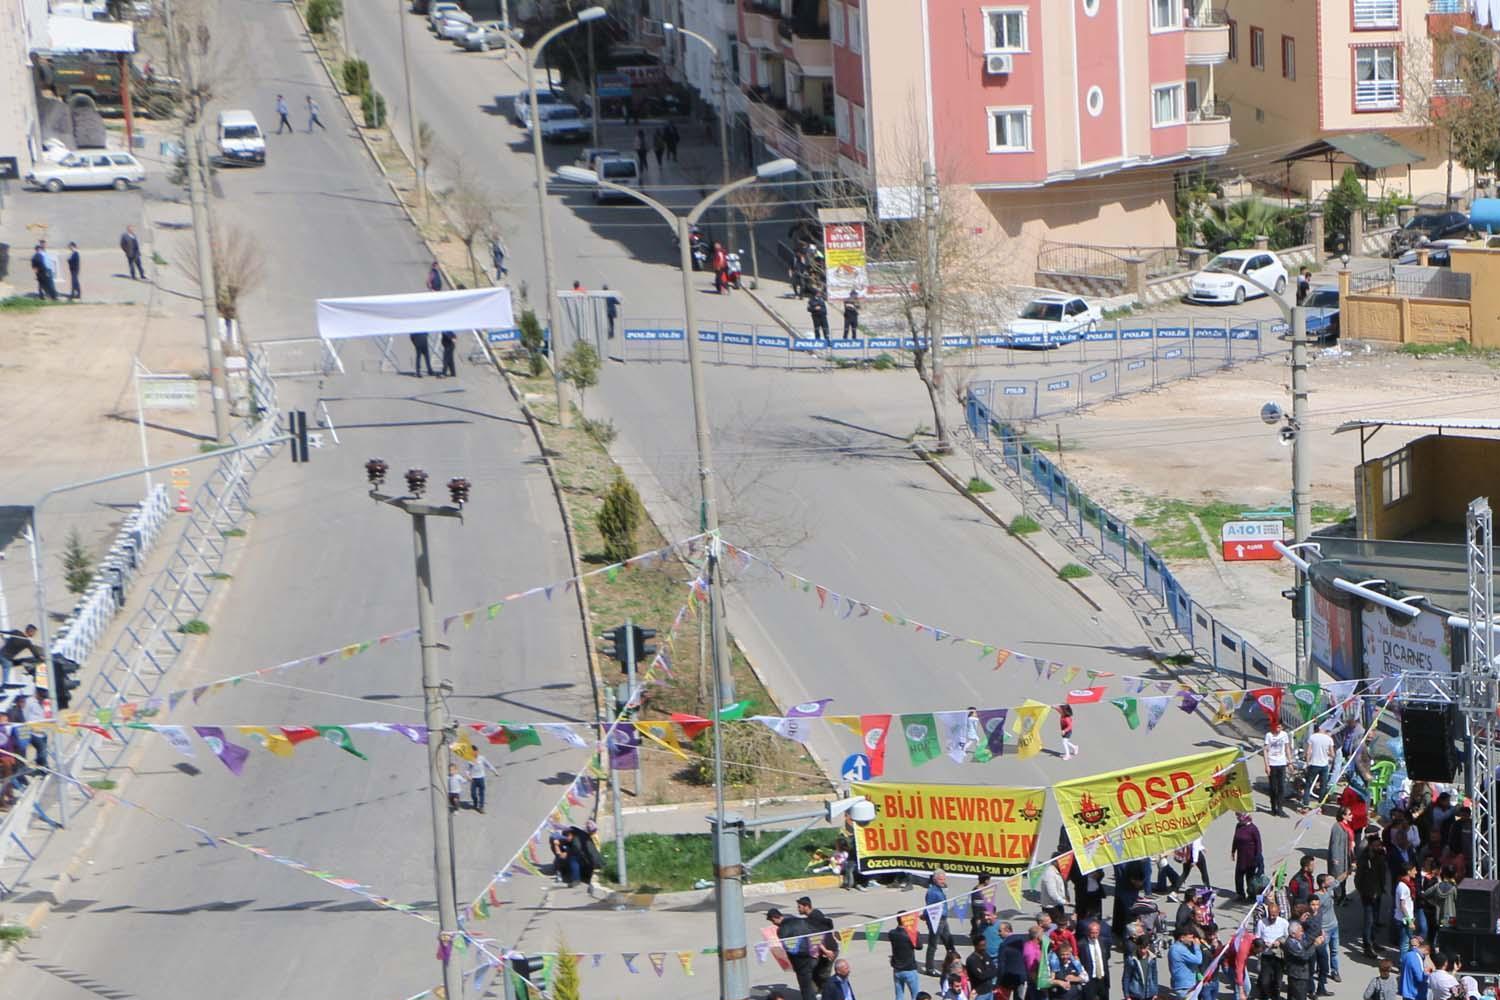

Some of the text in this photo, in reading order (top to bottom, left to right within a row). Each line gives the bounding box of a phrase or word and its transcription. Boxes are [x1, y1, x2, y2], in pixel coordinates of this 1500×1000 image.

[1087, 331, 1113, 340] POLİS
[1123, 330, 1150, 339] POLİS
[1159, 329, 1186, 337] POLİS
[723, 335, 750, 344] POLİS
[758, 337, 786, 346] POLİS
[796, 339, 824, 348] POLİS
[834, 340, 861, 348] POLİS
[870, 339, 897, 348] POLİS
[1015, 335, 1041, 344] POLİS
[1117, 772, 1194, 820] ÖSP
[884, 791, 1017, 823] BİJİ NEWROZ
[1141, 825, 1154, 836] VE
[863, 823, 909, 851] BİJİ
[867, 859, 924, 869] ÖZGÜRLÜK
[944, 864, 1000, 874] SOSYALİZM
